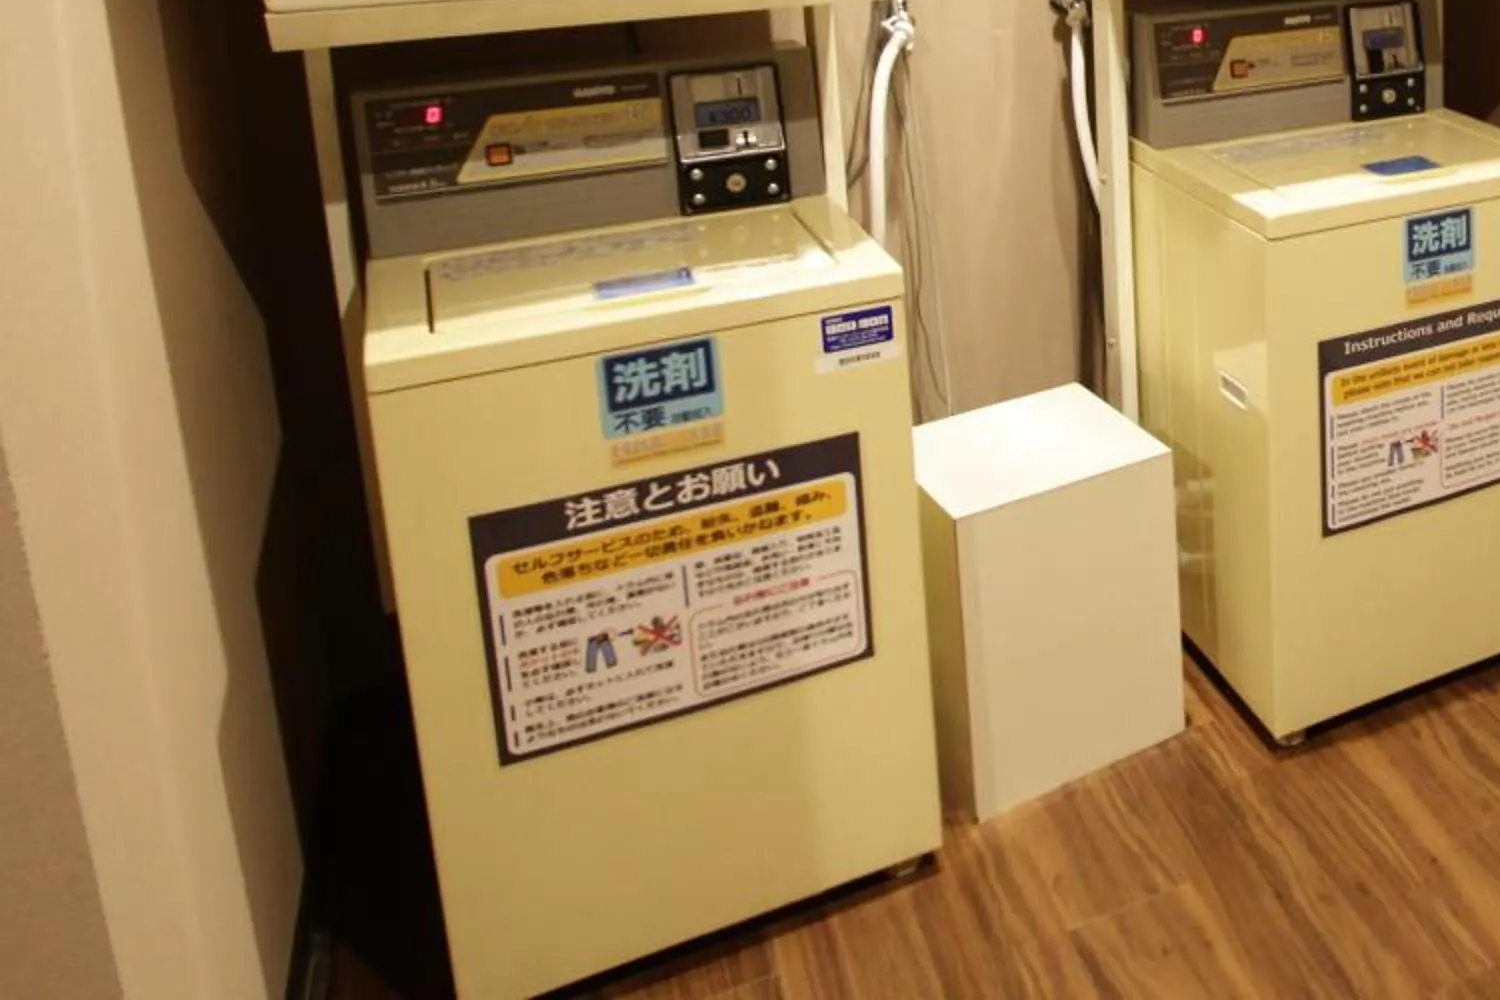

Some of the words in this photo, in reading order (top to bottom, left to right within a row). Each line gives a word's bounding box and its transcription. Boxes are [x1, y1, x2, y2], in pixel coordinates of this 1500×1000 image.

[1411, 214, 1468, 256] 洗剤
[1343, 324, 1434, 355] Instructions
[1437, 316, 1463, 333] and
[611, 346, 709, 404] 洗剤
[613, 405, 668, 435] 不要
[563, 457, 781, 531] 注意とお願い
